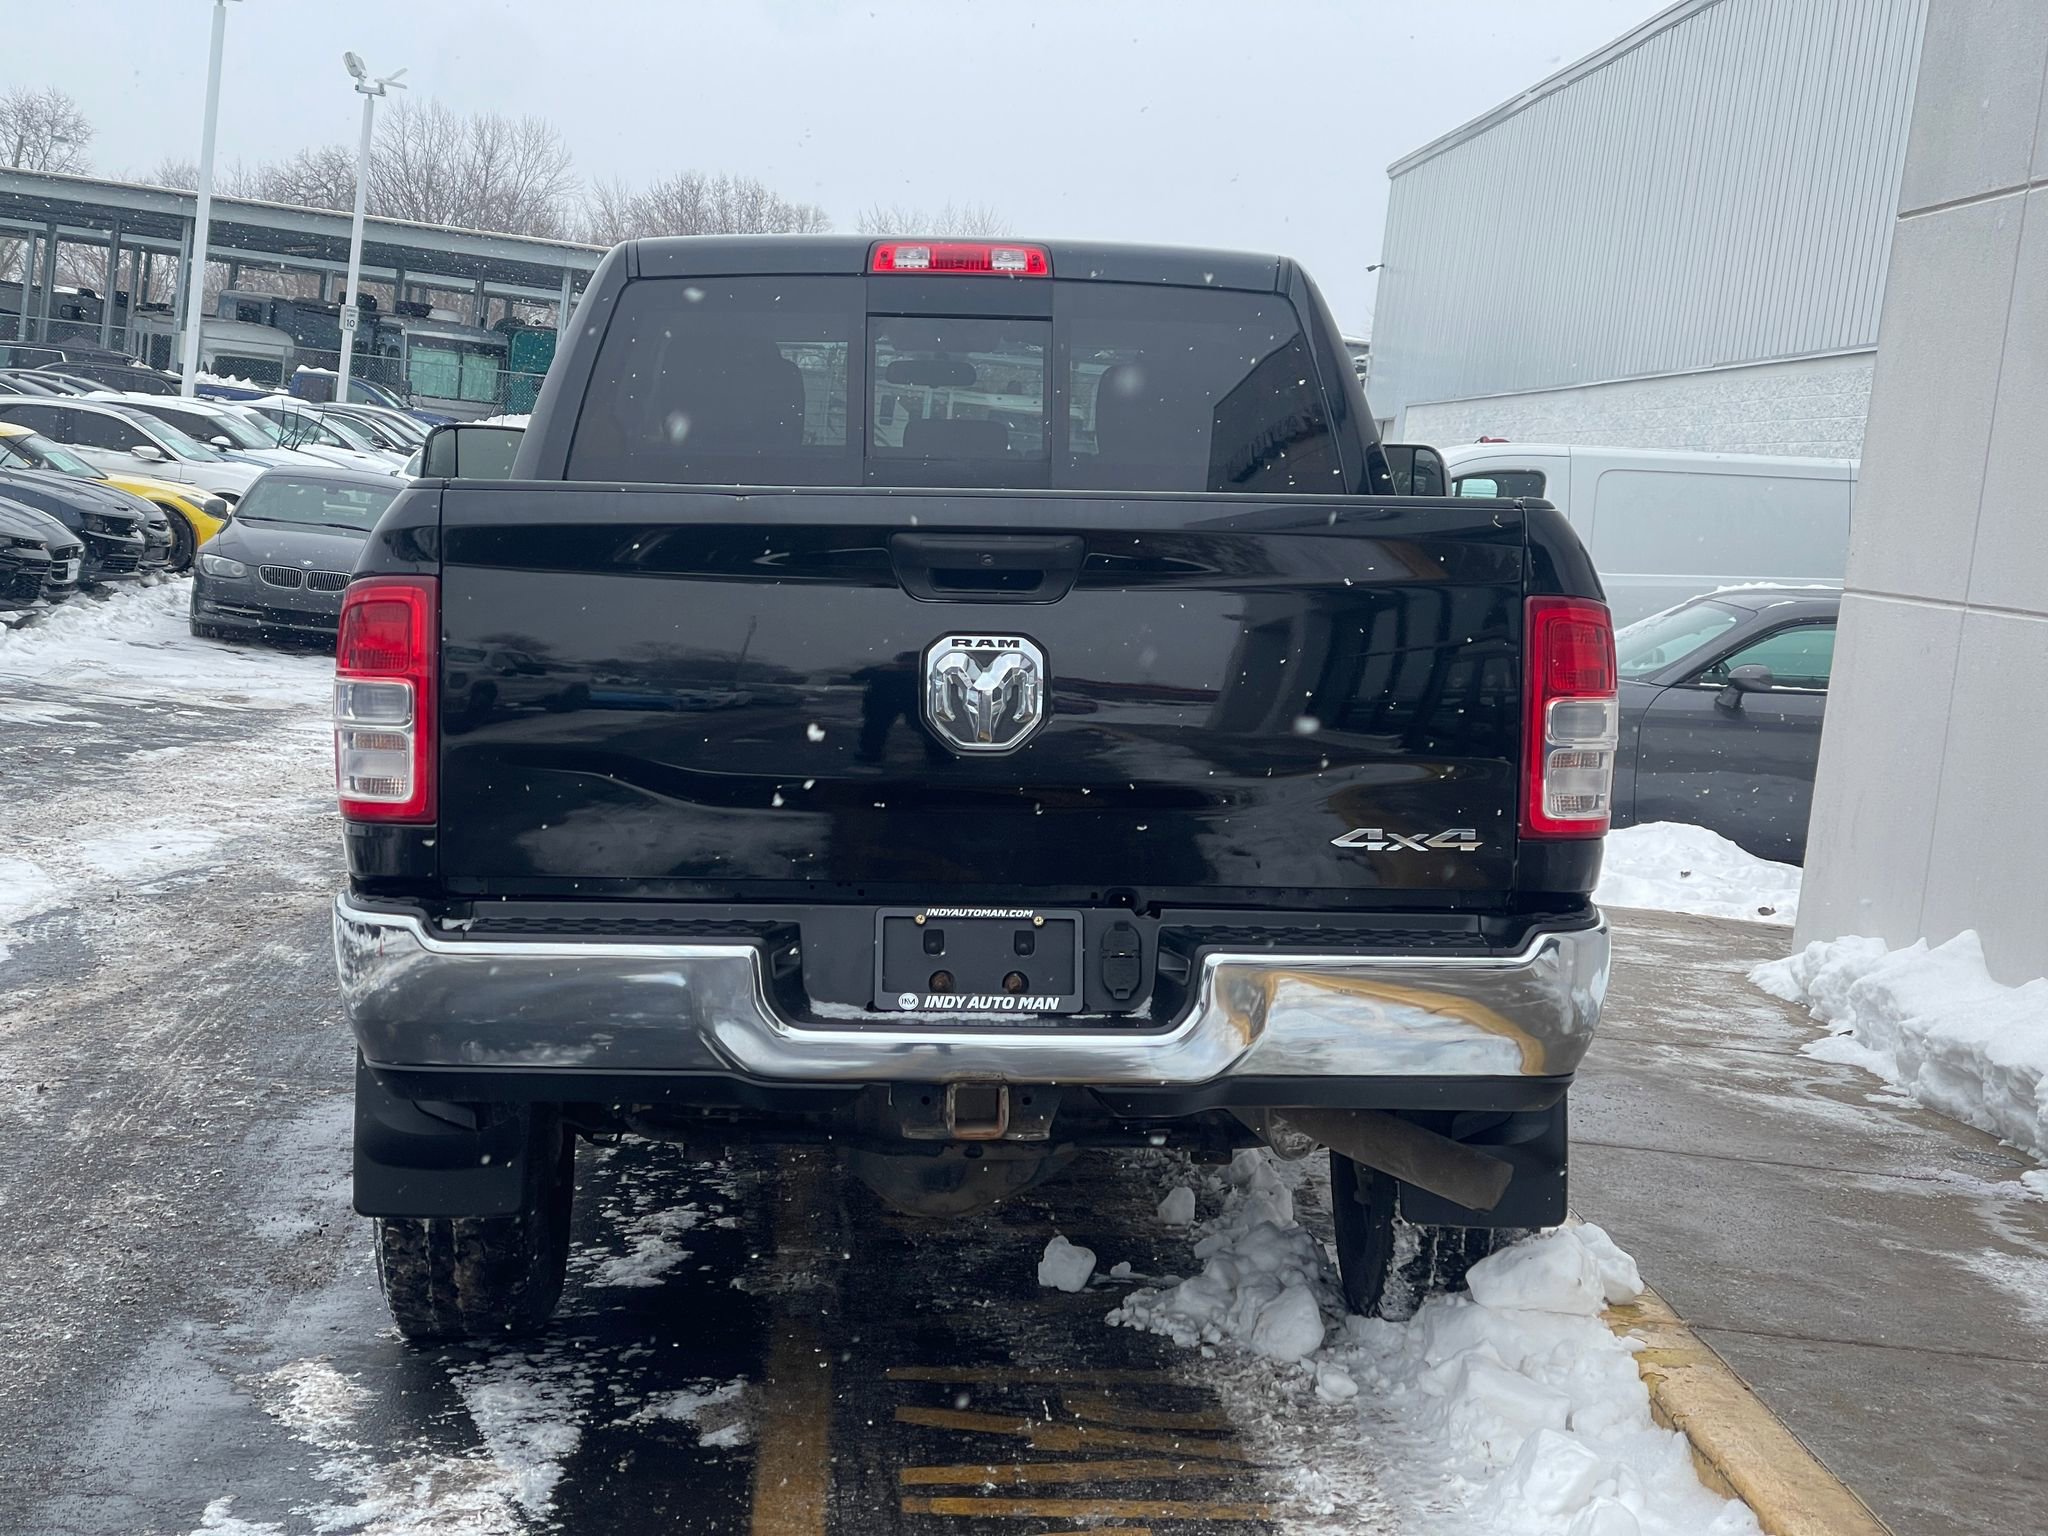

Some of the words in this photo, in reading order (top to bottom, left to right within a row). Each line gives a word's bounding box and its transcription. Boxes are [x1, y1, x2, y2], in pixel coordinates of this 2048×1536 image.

[346, 318, 355, 327] 10
[951, 638, 1020, 649] RAM
[926, 908, 1034, 918] INDYAUTOMAN.COM
[924, 995, 967, 1009] INDY
[966, 996, 1016, 1010] AUTO
[1017, 996, 1060, 1010] MAN
